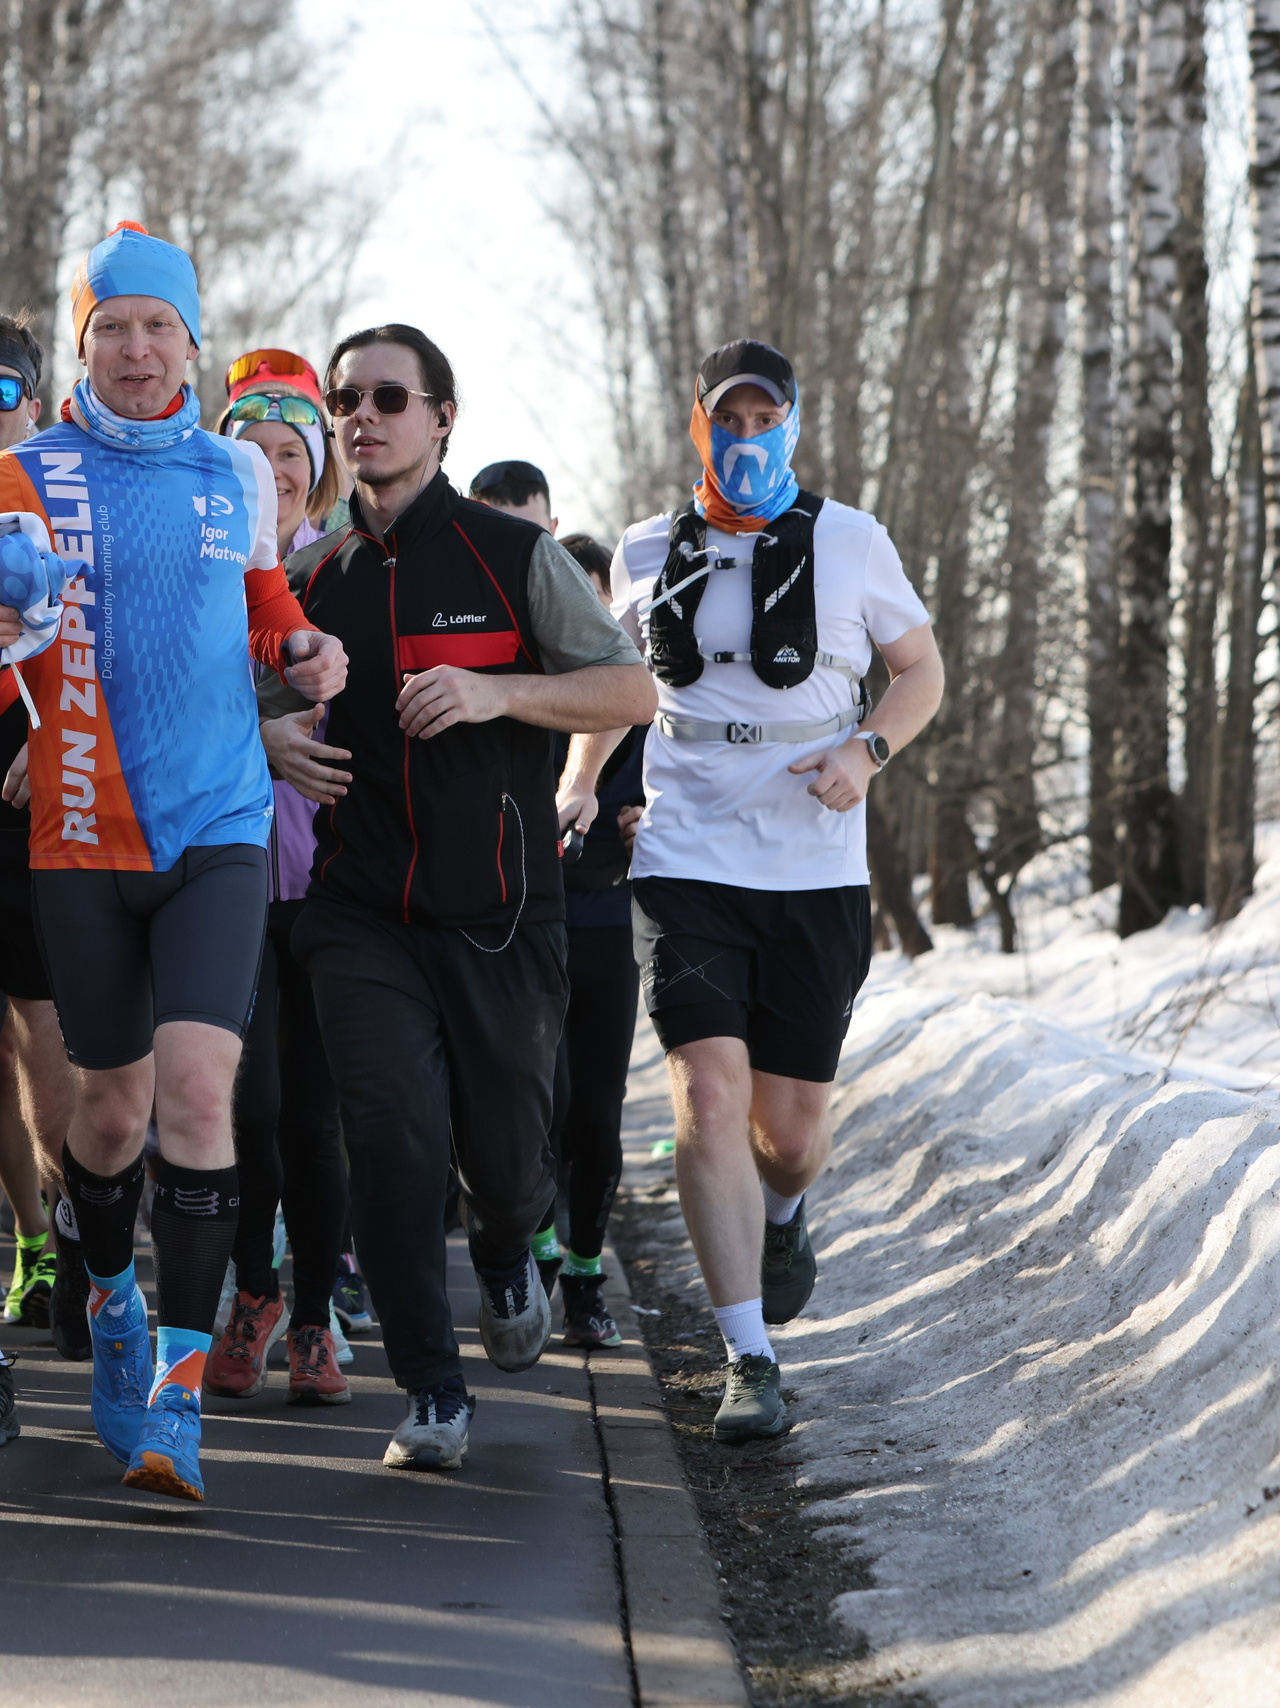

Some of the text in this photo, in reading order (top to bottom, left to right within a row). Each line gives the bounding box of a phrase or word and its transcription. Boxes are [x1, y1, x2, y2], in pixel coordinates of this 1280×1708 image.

[201, 523, 229, 542] Igor
[96, 504, 116, 680] Dolgoprudny running club
[449, 614, 487, 624] Löffler
[61, 727, 99, 846] RUN
